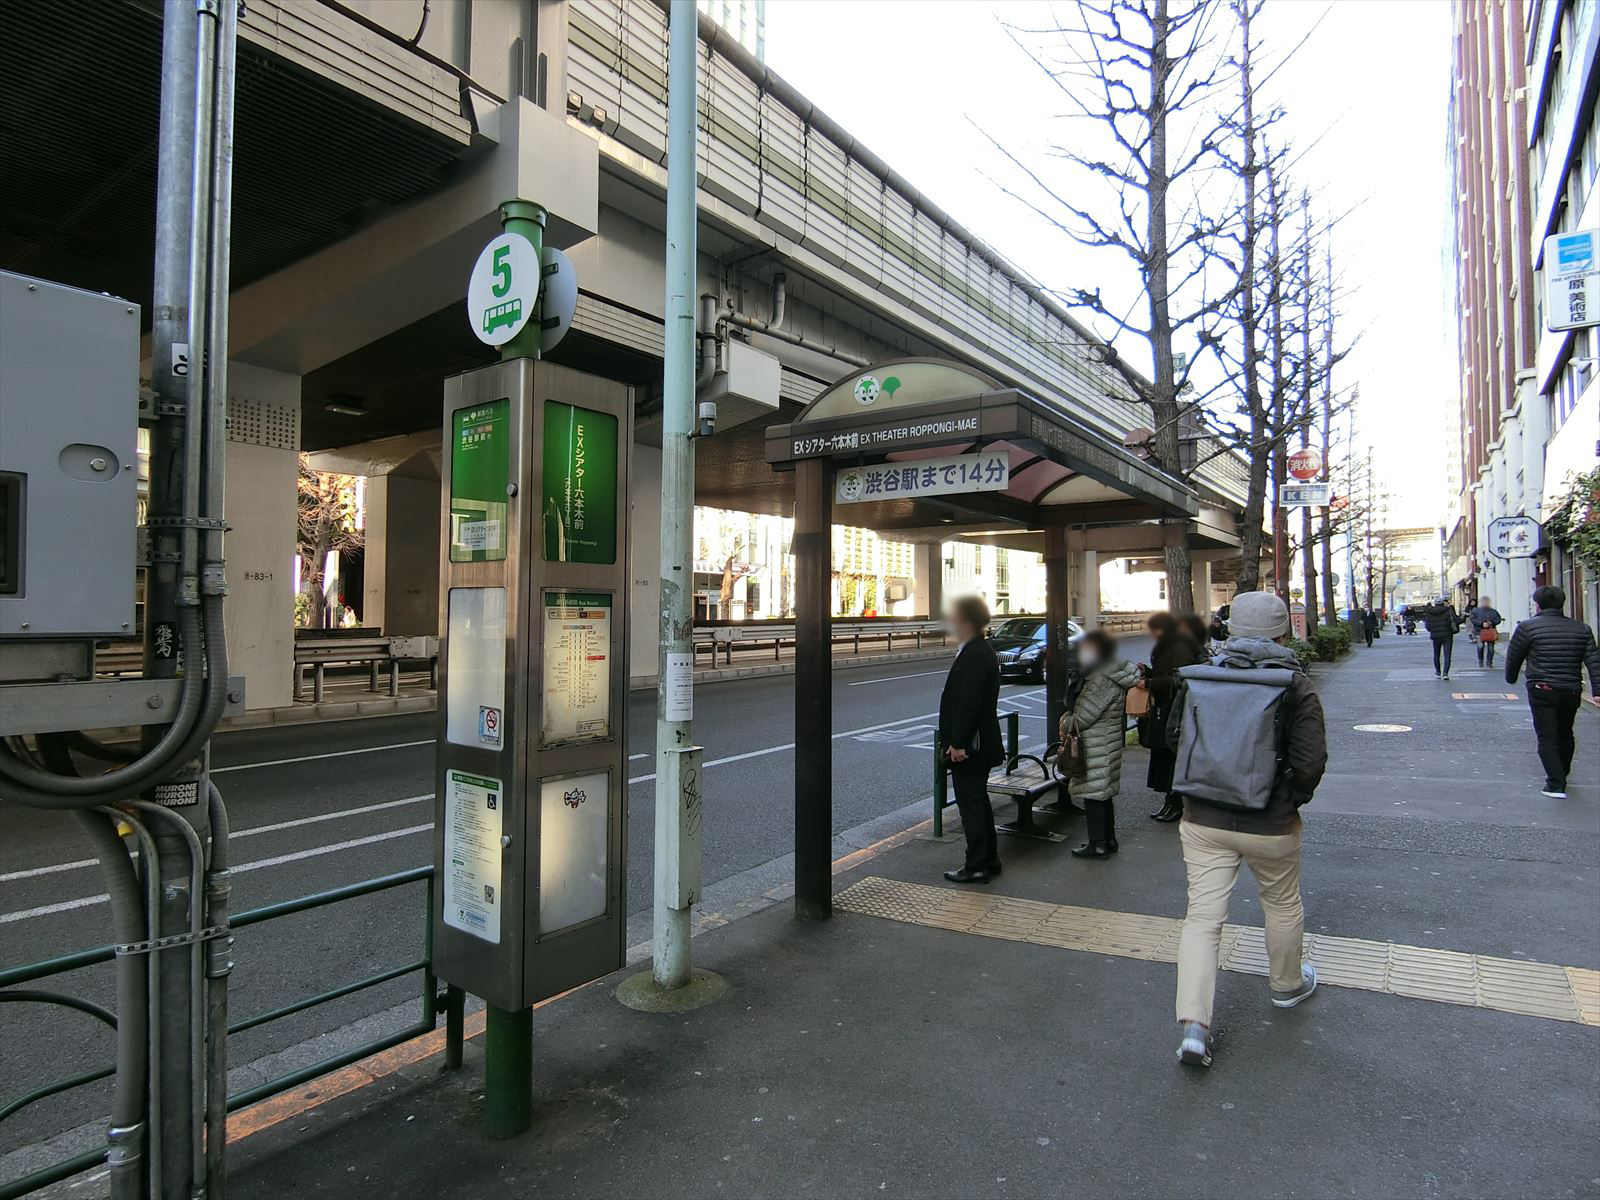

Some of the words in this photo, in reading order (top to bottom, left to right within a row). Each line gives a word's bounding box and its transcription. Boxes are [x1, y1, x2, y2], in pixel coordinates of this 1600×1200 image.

[491, 244, 512, 298] 5
[794, 433, 858, 455] EXシアター六本木前
[860, 433, 870, 445] EX
[872, 428, 908, 442] THEATER
[910, 418, 977, 437] ROPPONGI-MAE
[574, 424, 585, 530] EXシアター六本木前
[865, 458, 1006, 494] 渋谷駅まで14分
[155, 783, 198, 792] MURONE
[155, 790, 197, 799] MURONE
